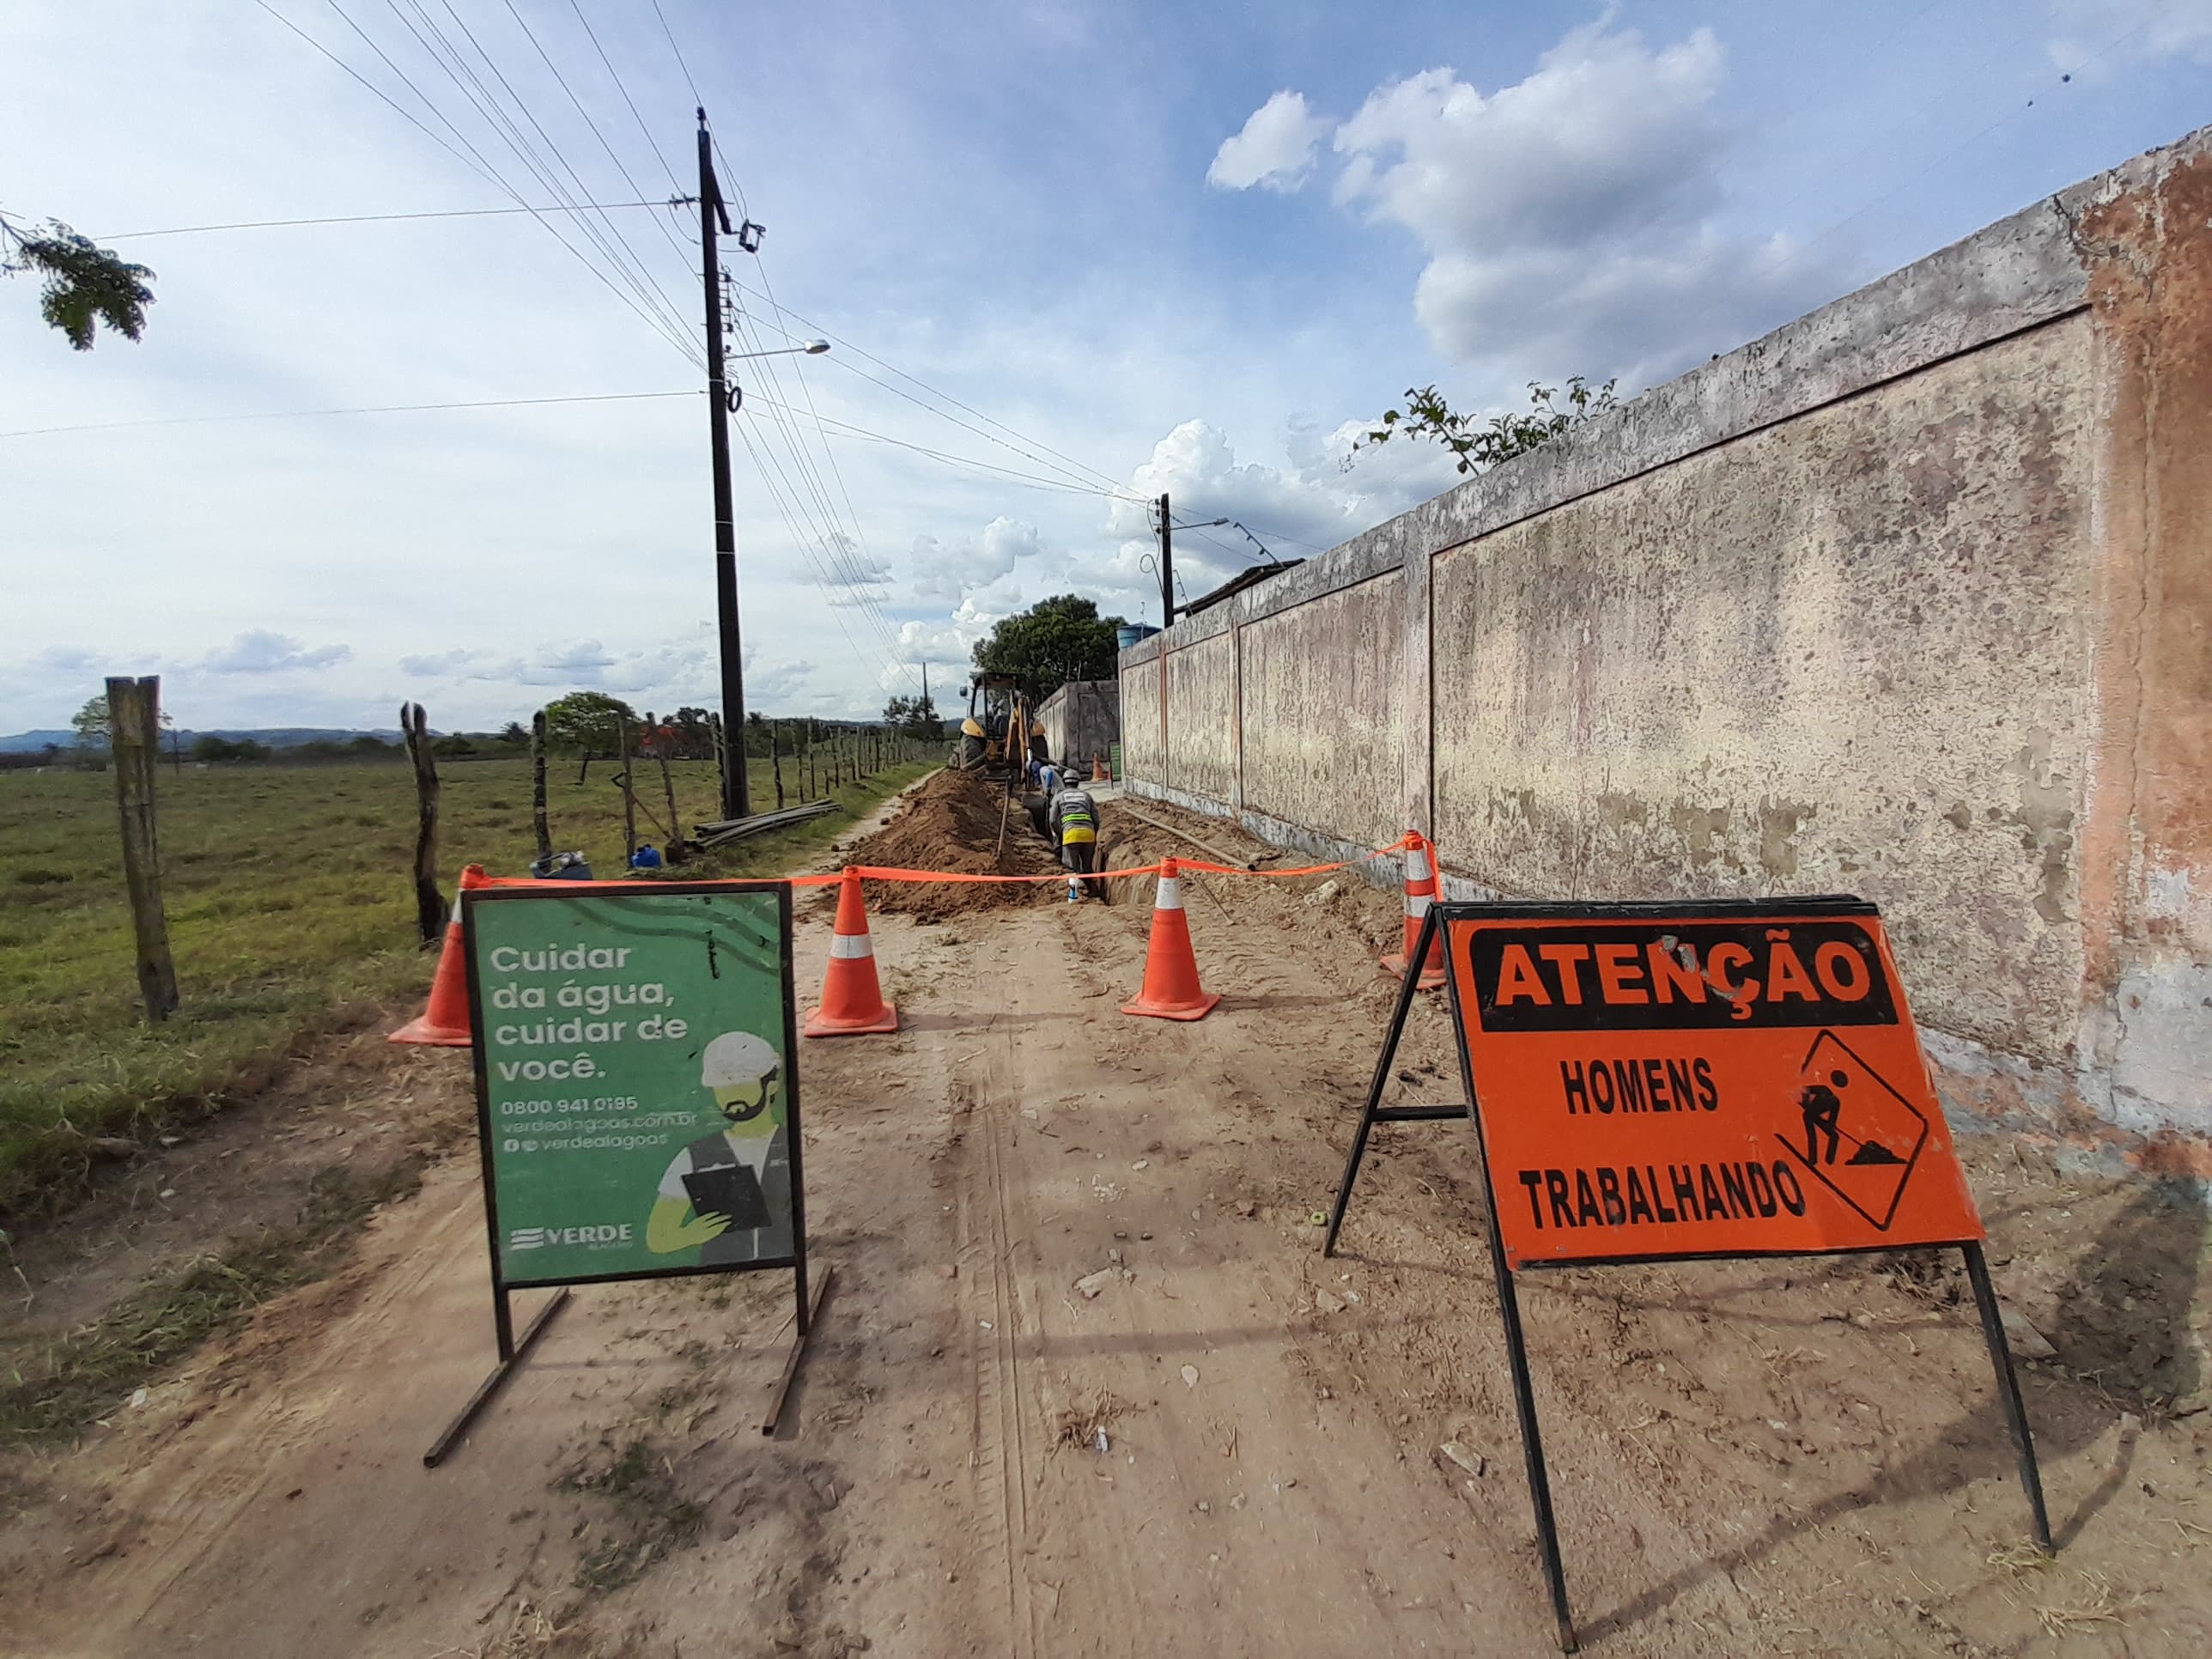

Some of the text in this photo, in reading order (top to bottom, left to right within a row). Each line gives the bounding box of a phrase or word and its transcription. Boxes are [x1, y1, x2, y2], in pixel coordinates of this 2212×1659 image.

[490, 943, 631, 972] Cuidar
[1495, 928, 1870, 1020] ATENÇÃO
[493, 979, 675, 1015] da água,
[495, 1015, 688, 1045] cuidar de
[499, 1053, 606, 1081] você.
[1560, 1057, 1717, 1115] HOMENS
[501, 1100, 552, 1115] 0800
[557, 1098, 589, 1112] 941
[542, 1133, 667, 1151] verdealagoas
[1519, 1160, 1806, 1230] TRABALHANDO
[544, 1224, 633, 1246] VERDE
